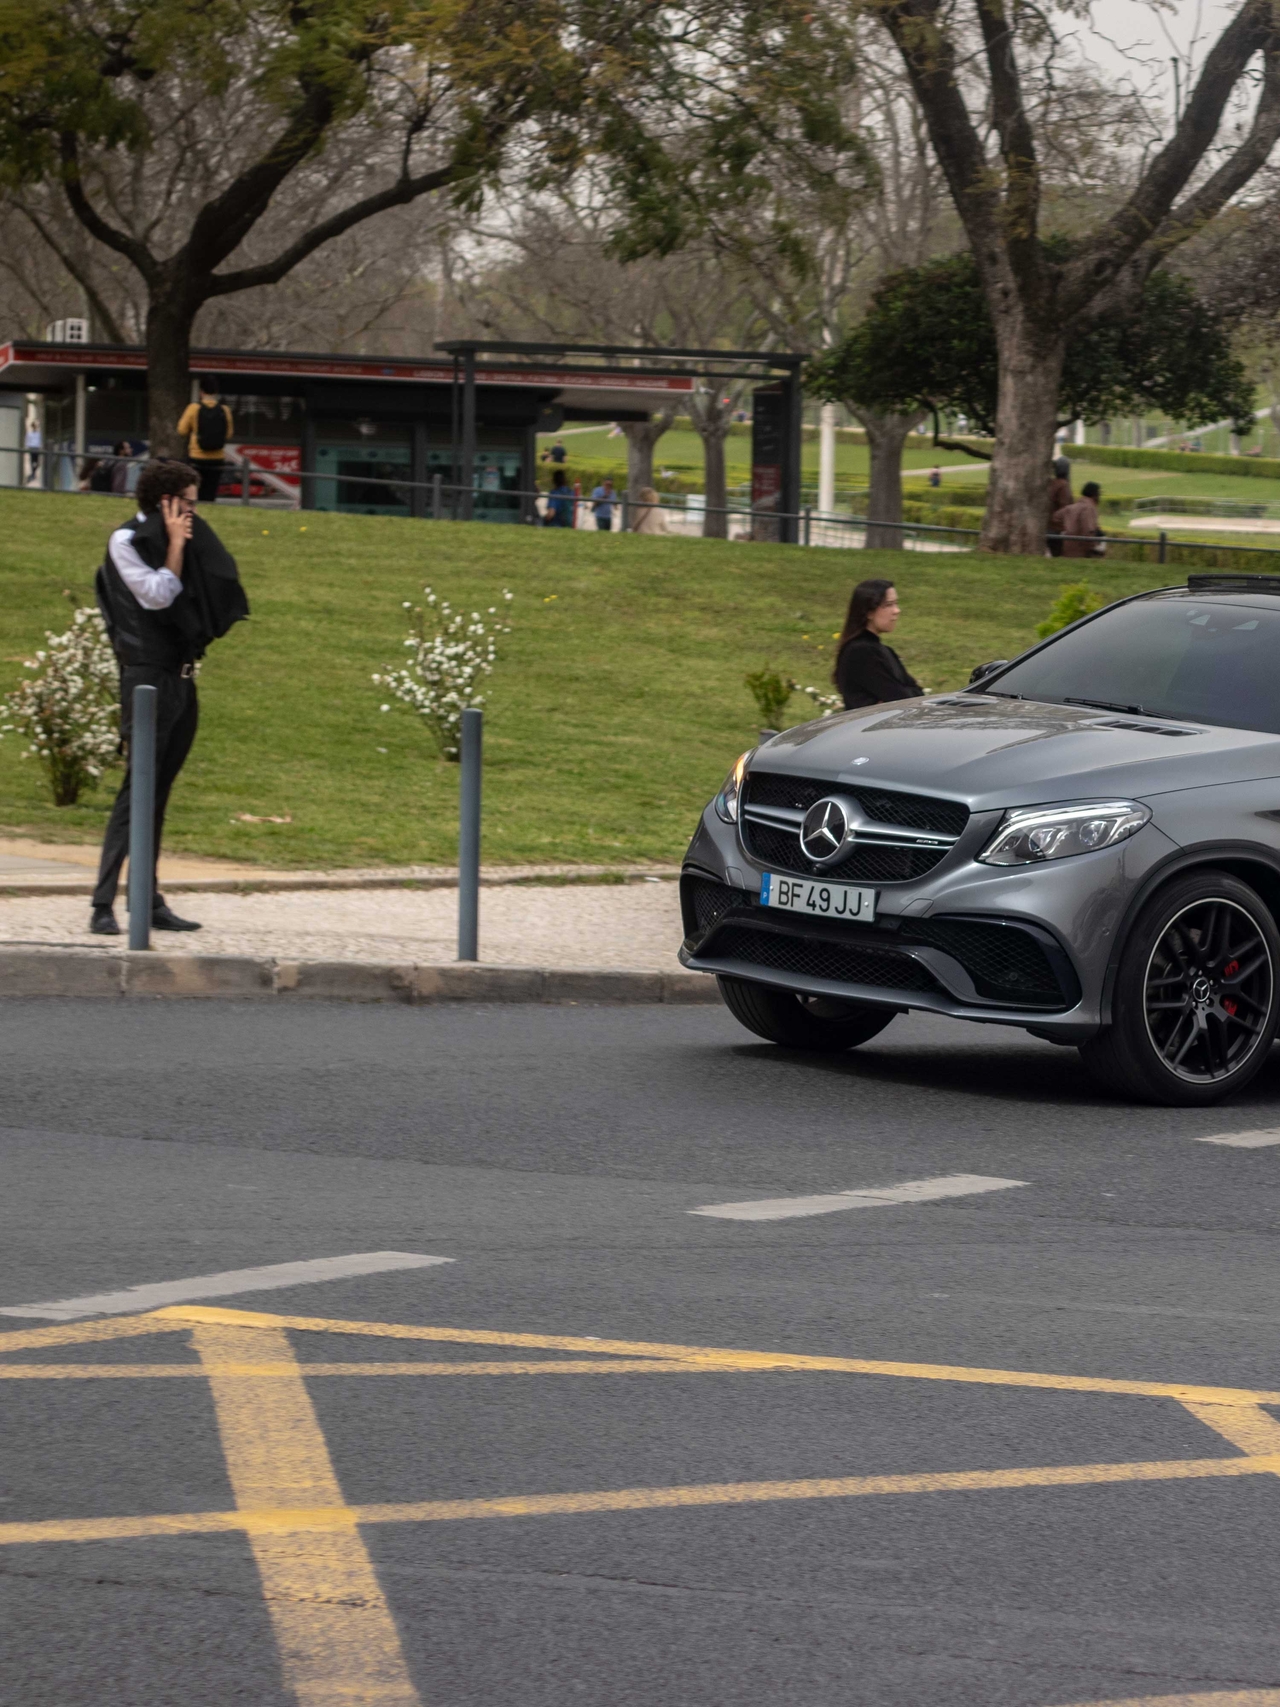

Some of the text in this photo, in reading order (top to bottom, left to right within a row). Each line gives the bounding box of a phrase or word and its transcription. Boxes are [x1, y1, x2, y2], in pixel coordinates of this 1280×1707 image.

[778, 880, 862, 916] BF 49 JJ
